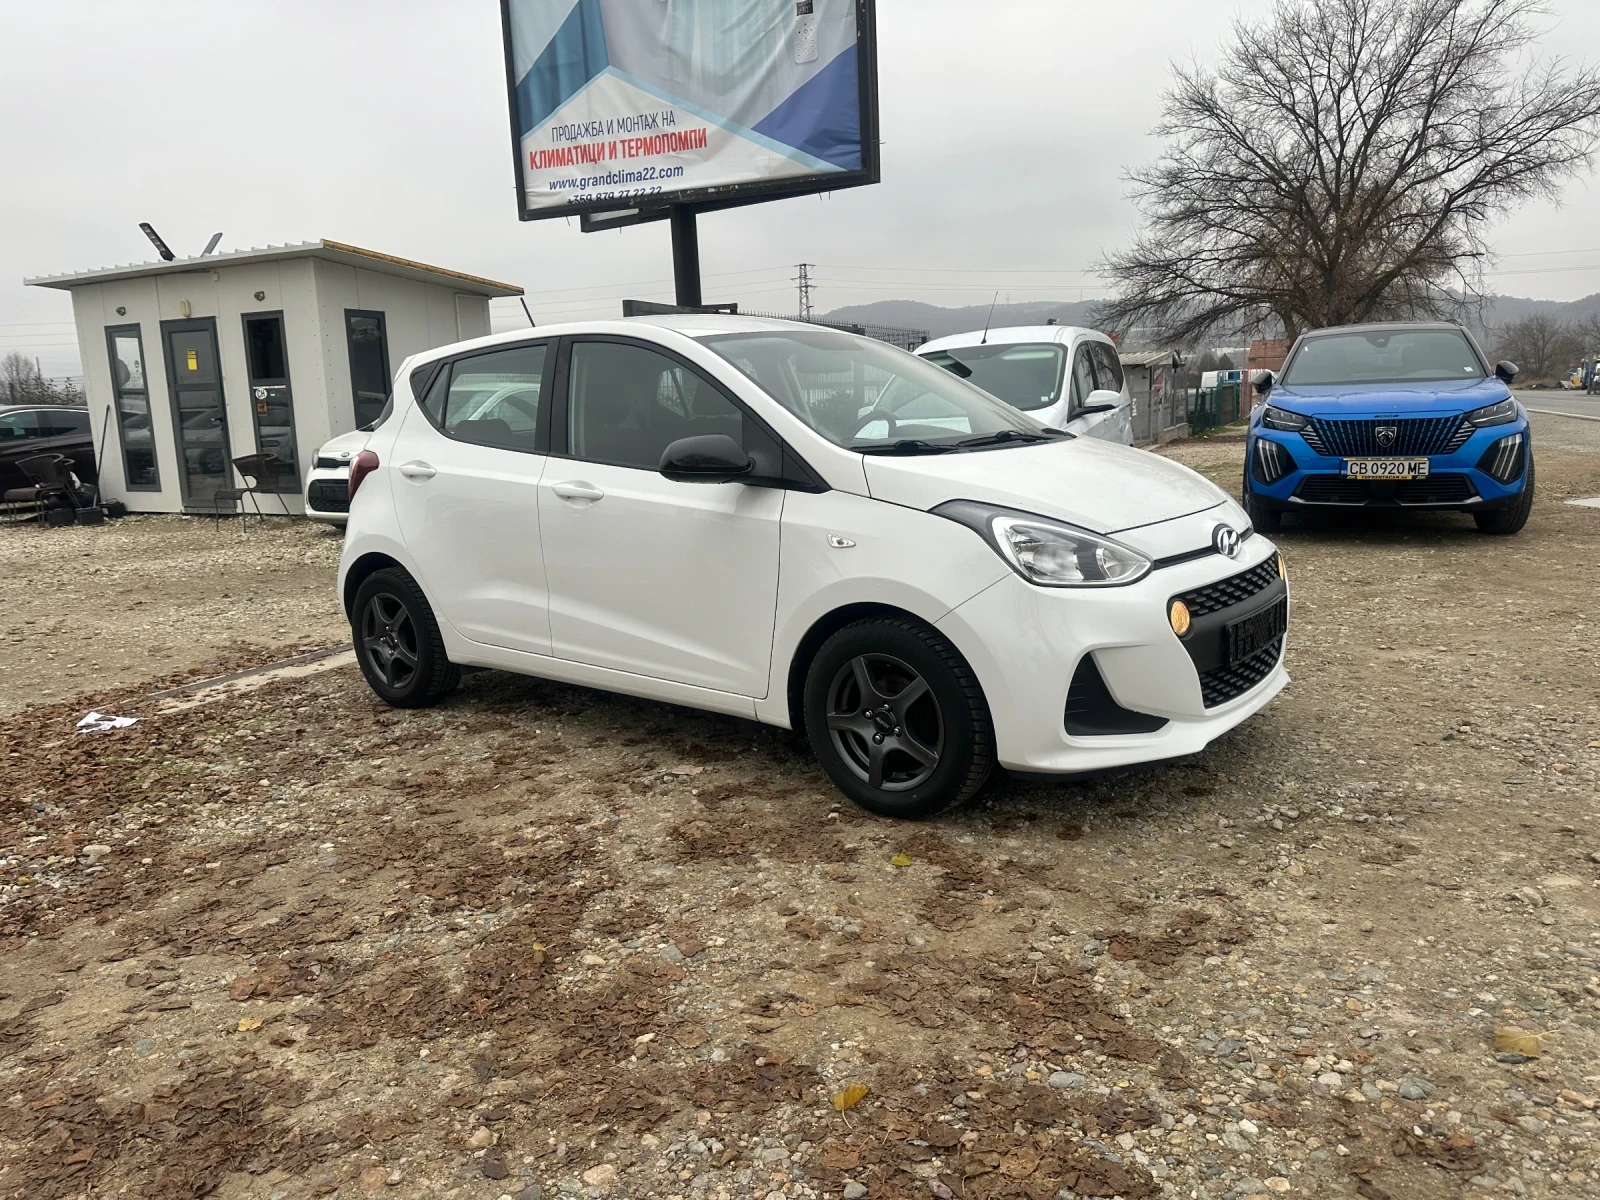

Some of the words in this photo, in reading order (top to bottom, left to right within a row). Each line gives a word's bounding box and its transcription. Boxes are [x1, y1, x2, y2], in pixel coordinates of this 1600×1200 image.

[552, 120, 604, 142] ПРОДАЖБА
[606, 120, 614, 135] И
[617, 112, 659, 133] МОНТАЖ
[662, 110, 676, 127] НА
[529, 142, 605, 170] КЛИМАТИЦИ
[608, 140, 617, 160] И
[620, 128, 708, 159] ТЕРМОПОМПИ
[549, 165, 684, 190] www.grandclima22.com
[1349, 462, 1368, 475] CB
[1371, 462, 1405, 475] 0920
[1408, 462, 1427, 475] ME
